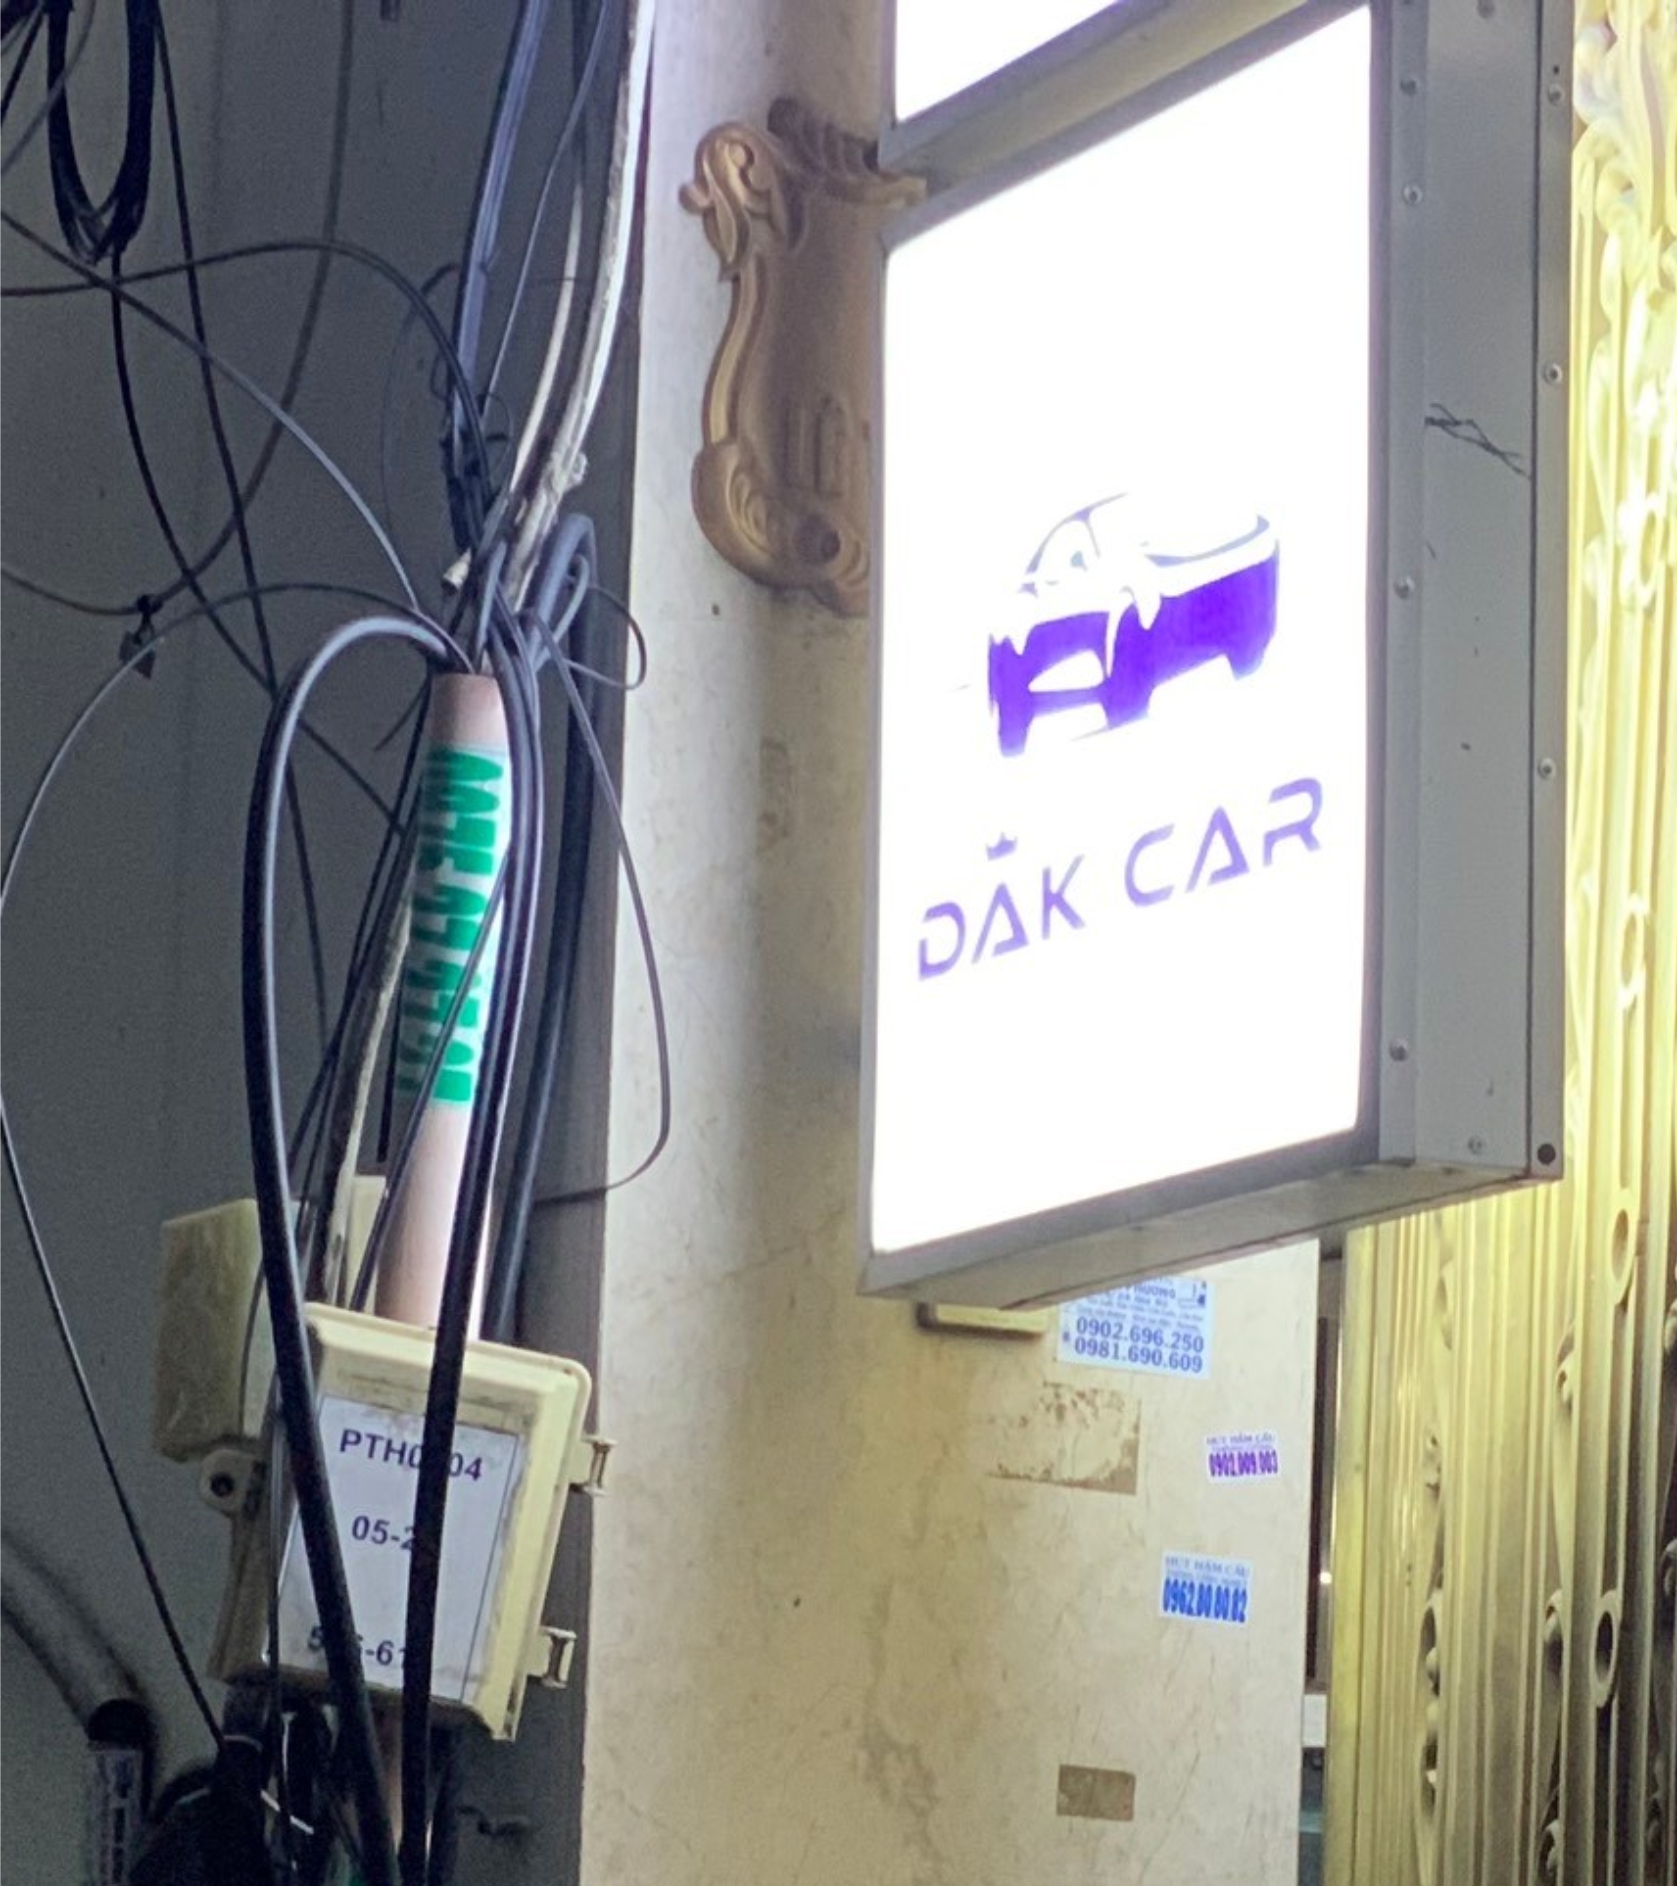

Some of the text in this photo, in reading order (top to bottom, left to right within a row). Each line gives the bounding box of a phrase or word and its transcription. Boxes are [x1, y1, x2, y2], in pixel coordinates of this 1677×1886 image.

[1123, 775, 1324, 907] CAR
[1074, 1337, 1204, 1374] 0981.690.609
[1076, 1316, 1205, 1354] 0902.696.250
[340, 1428, 484, 1482] PTH004
